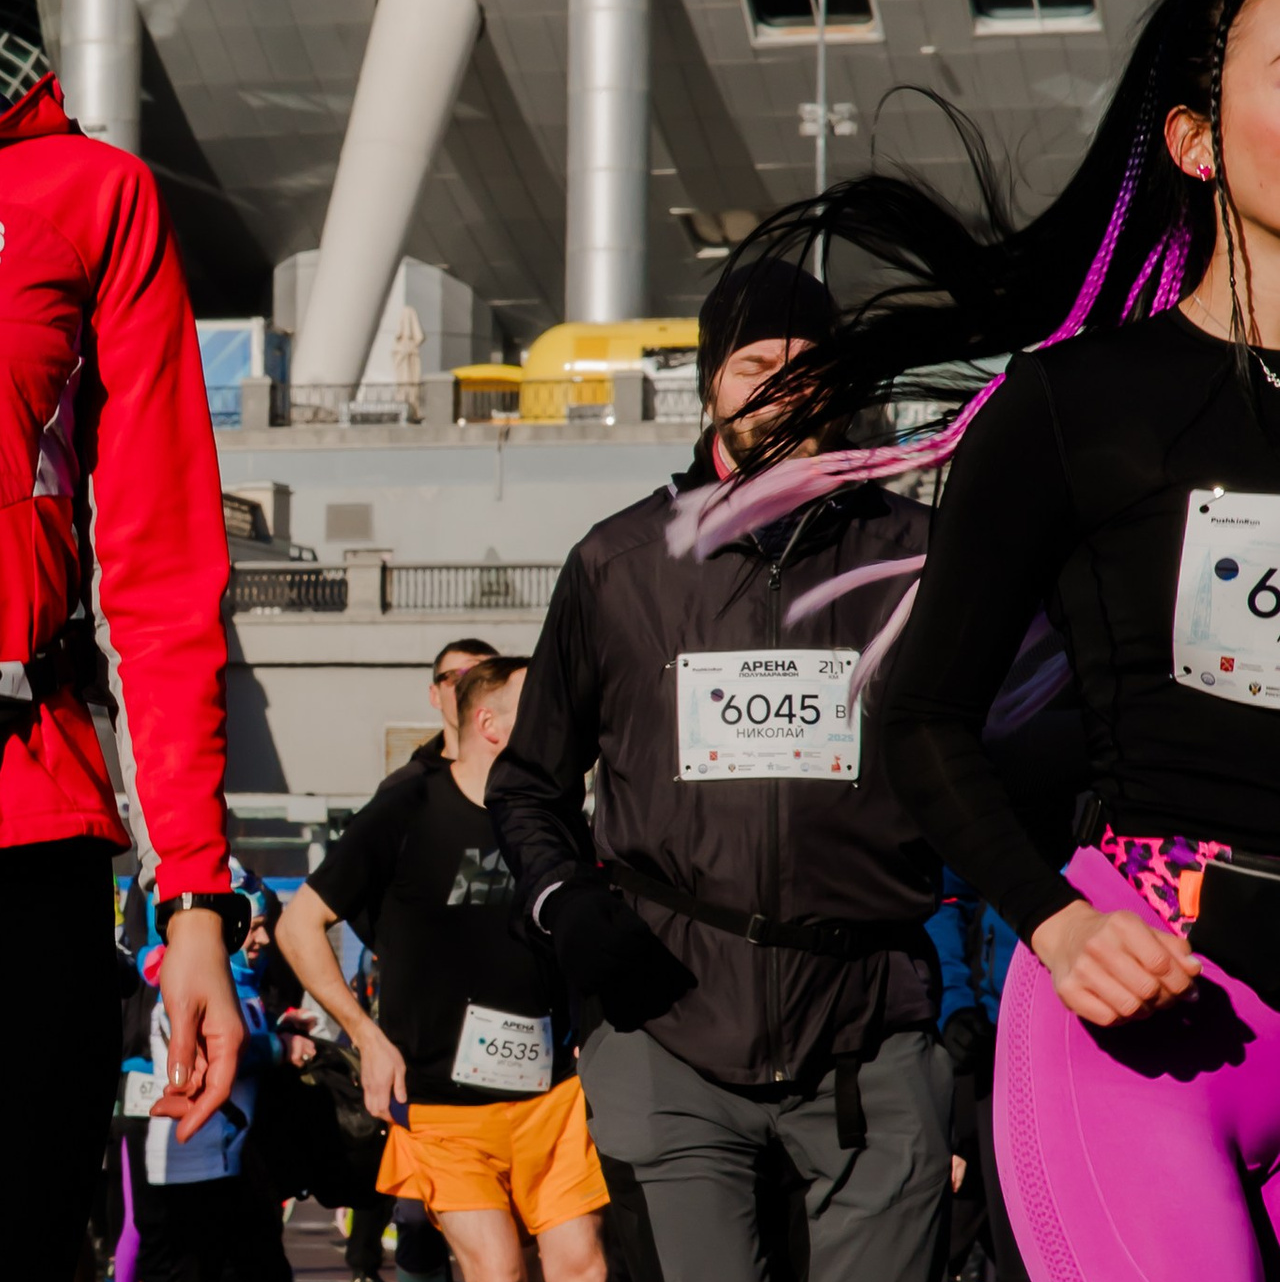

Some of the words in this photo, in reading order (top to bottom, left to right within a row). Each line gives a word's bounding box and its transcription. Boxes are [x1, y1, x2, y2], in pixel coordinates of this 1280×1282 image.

[740, 660, 798, 672] АРЕНА
[818, 660, 844, 676] 21,1
[721, 694, 821, 725] 6045
[736, 725, 804, 739] НИКОЛАЙ
[827, 733, 854, 743] 2025
[502, 1020, 535, 1032] АРЕНА
[485, 1038, 540, 1062] 6535
